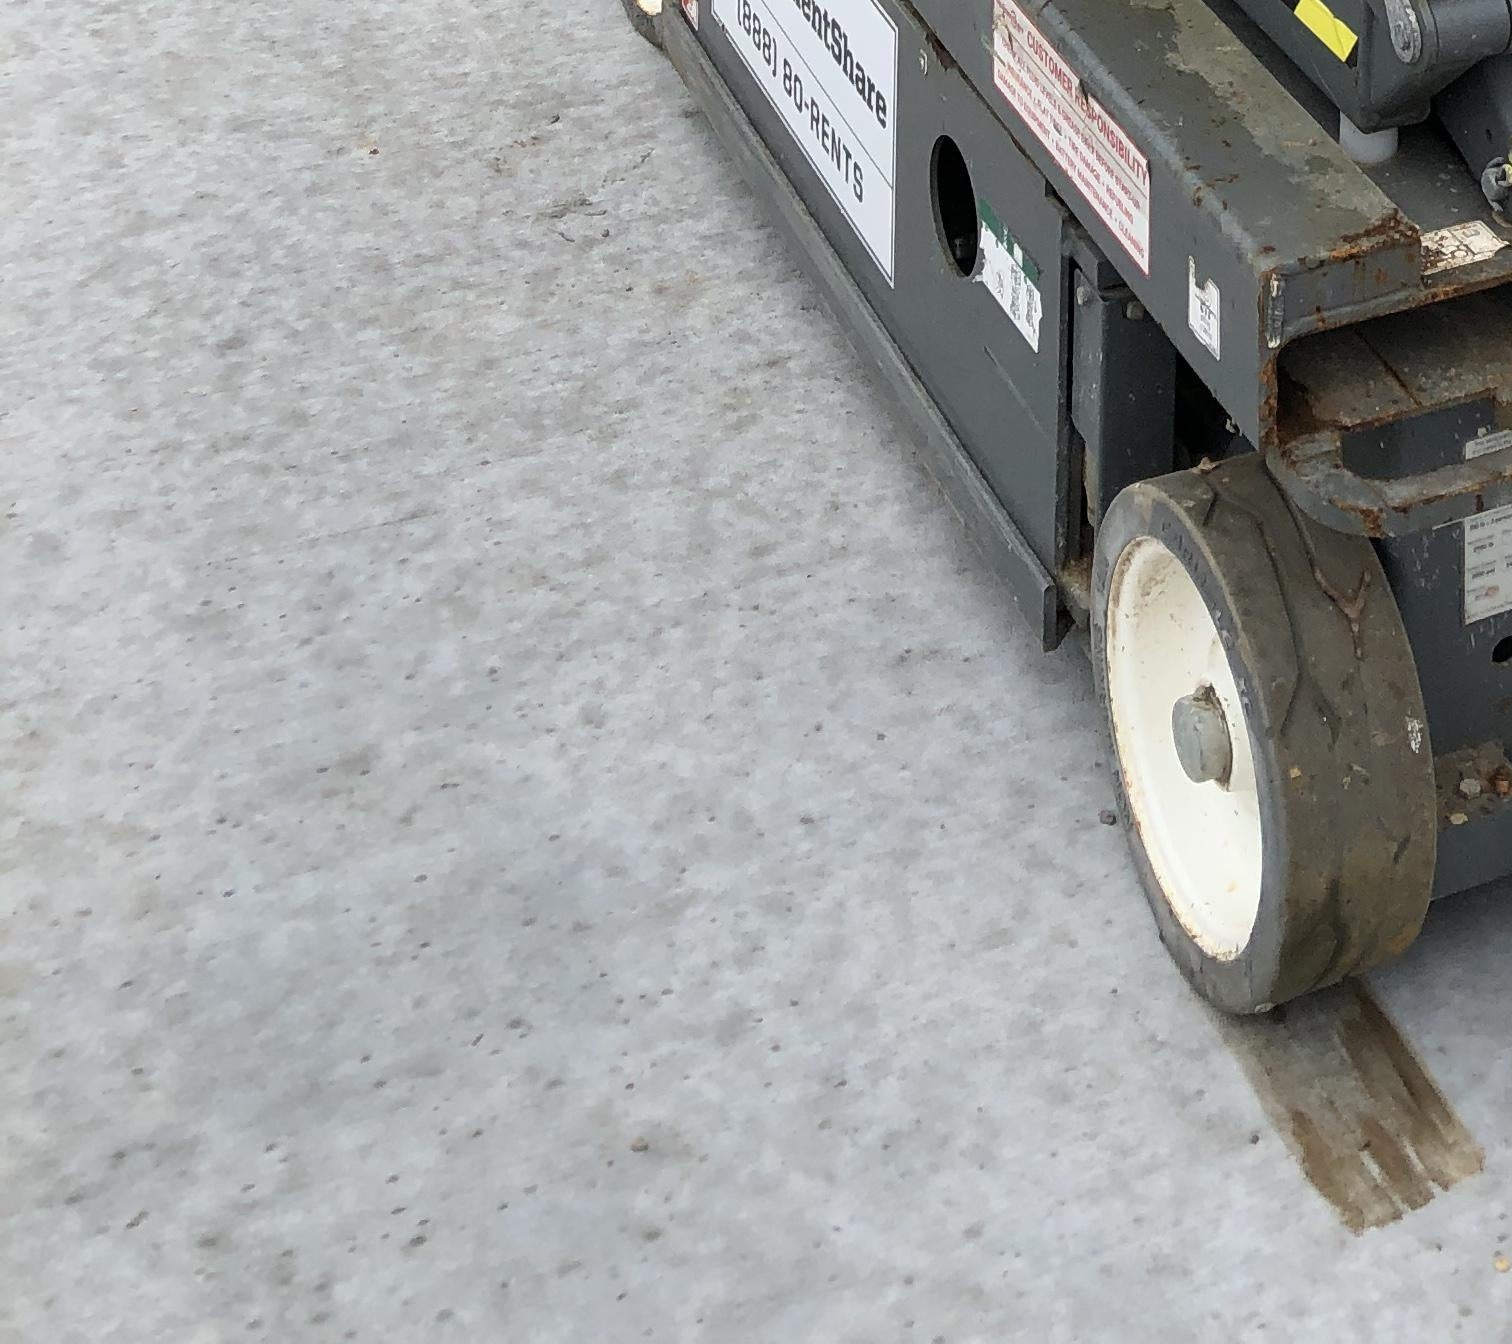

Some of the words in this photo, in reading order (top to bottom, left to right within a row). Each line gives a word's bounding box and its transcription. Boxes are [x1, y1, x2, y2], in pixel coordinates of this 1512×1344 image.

[782, 62, 866, 205] 80-RENTS
[1026, 31, 1072, 97] CUSTOMER
[1074, 89, 1147, 187] RESPONSIBILITY
